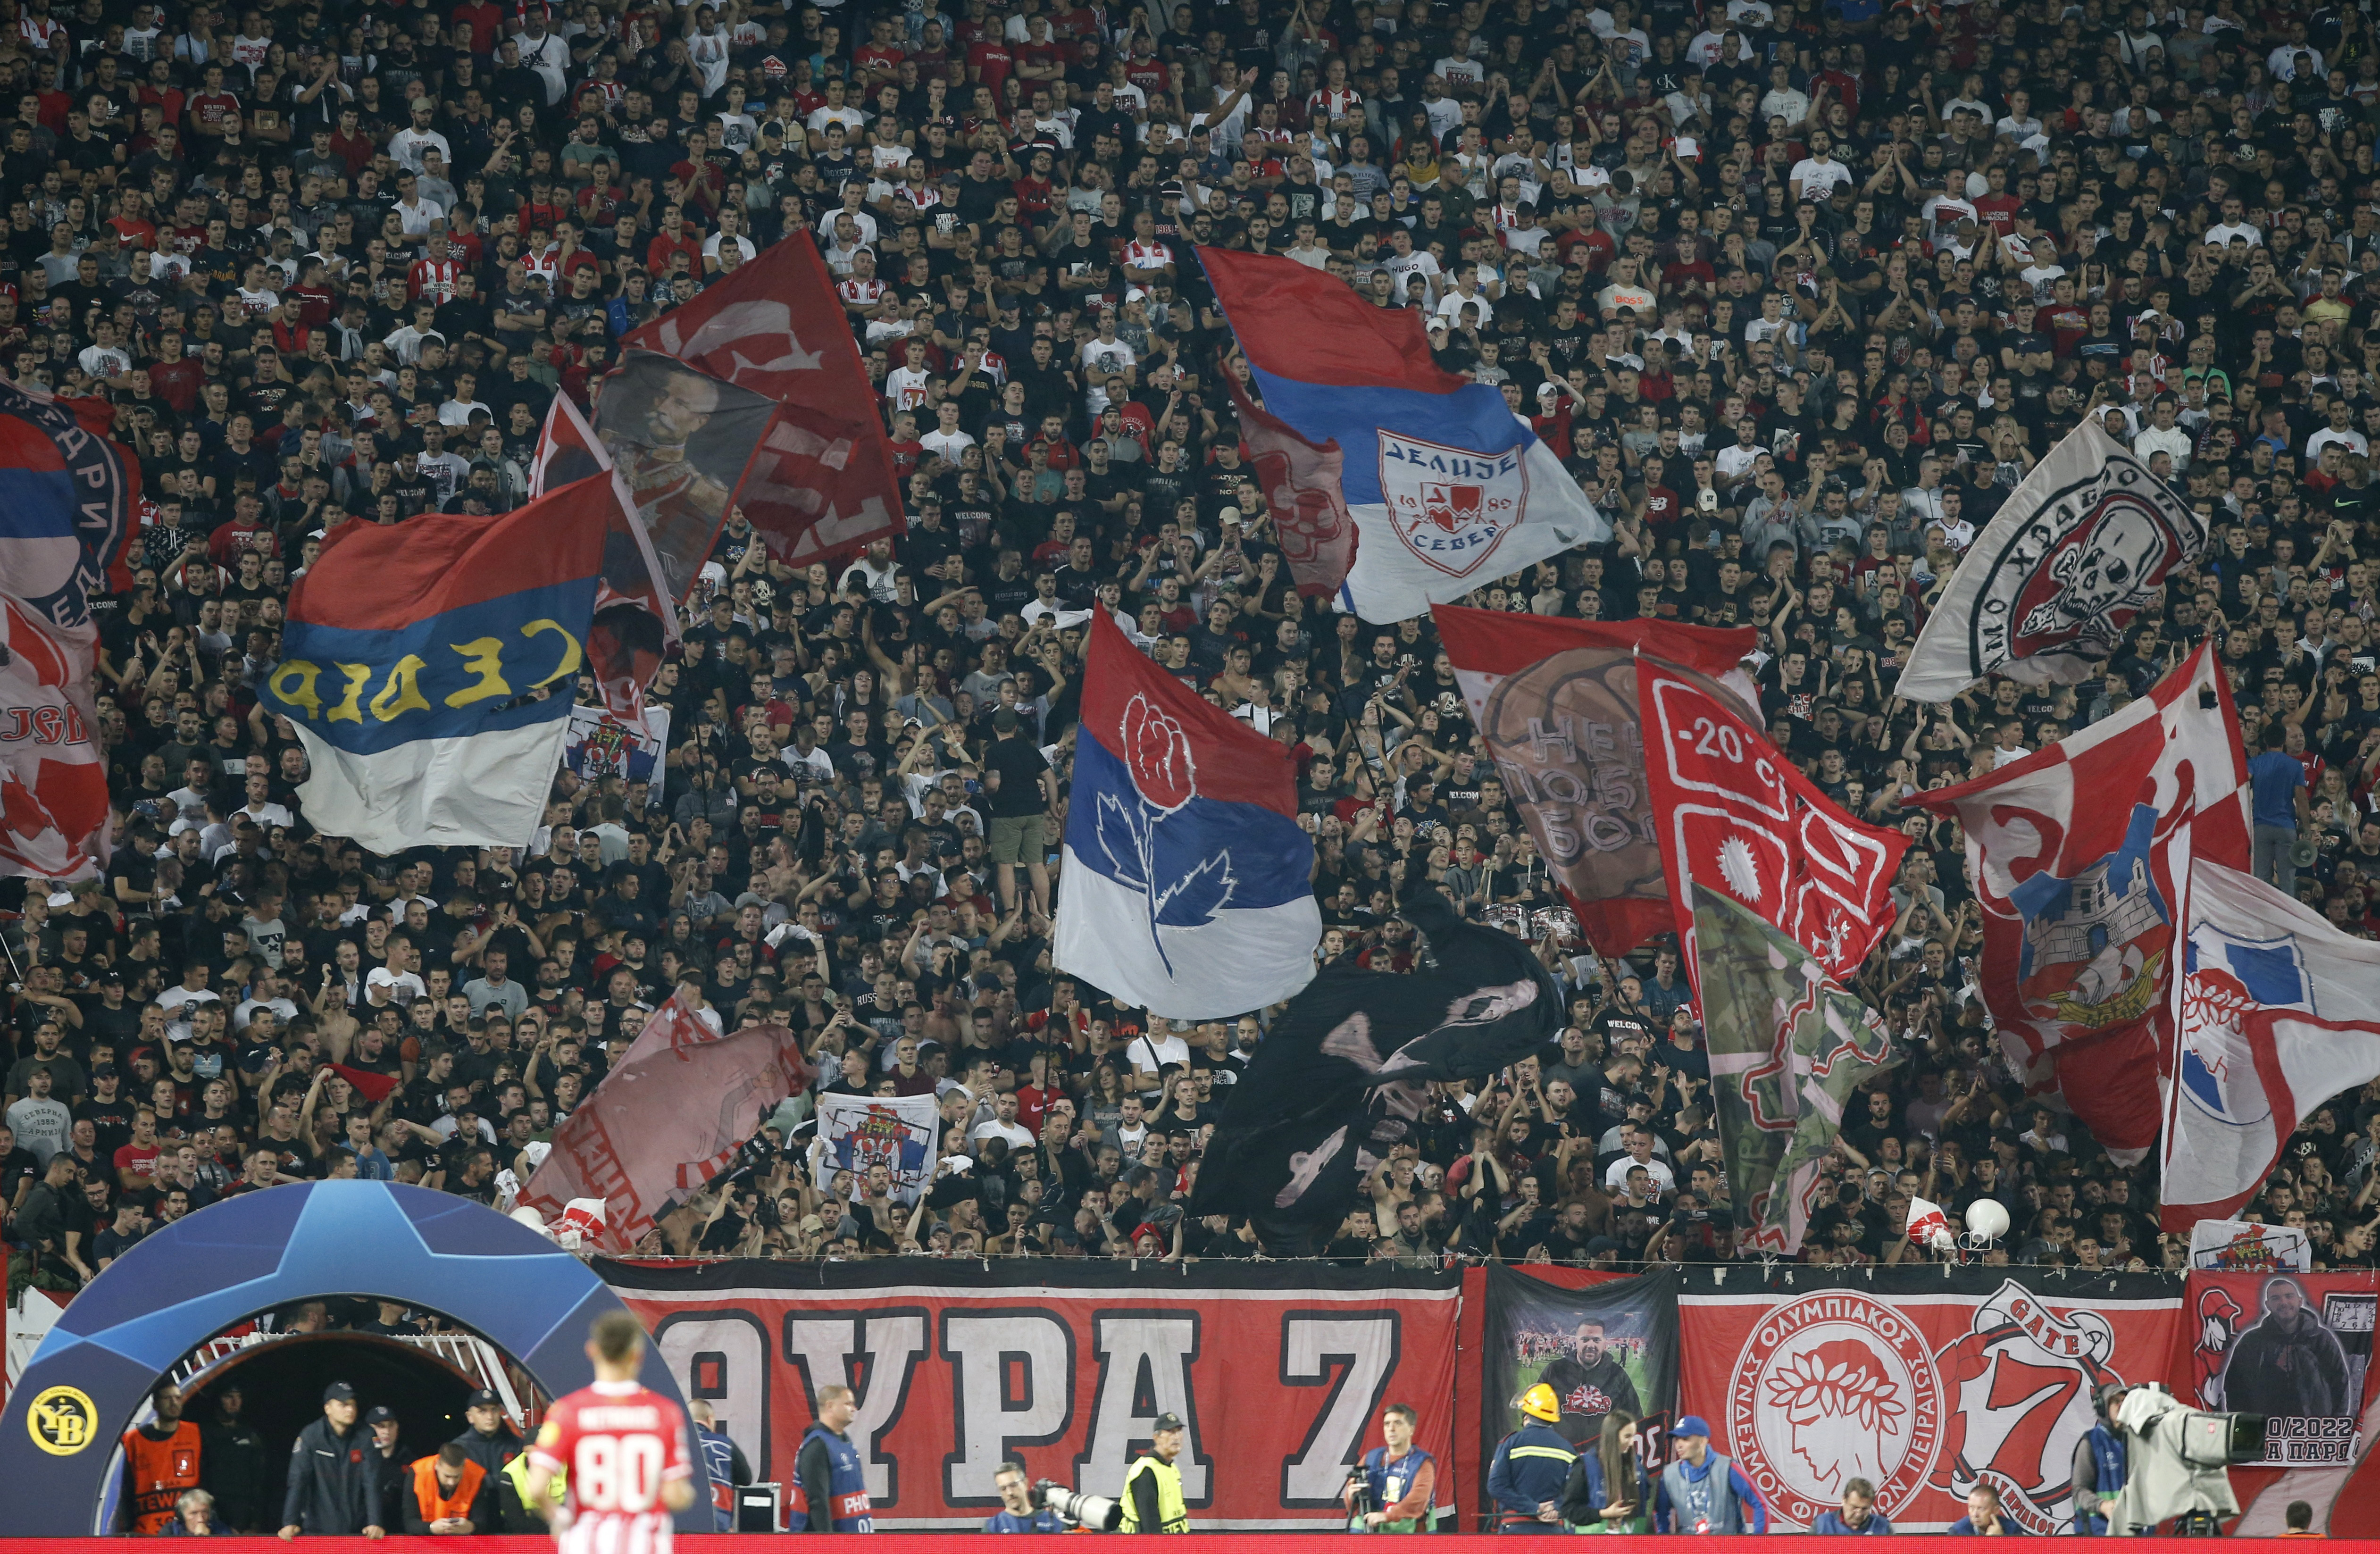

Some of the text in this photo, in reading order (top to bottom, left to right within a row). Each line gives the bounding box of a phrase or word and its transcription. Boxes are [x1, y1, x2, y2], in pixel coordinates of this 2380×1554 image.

[519, 59, 550, 67] addas
[1935, 204, 1969, 213] МАРАКАНА
[1155, 224, 1174, 234] 1989
[386, 251, 412, 259] ELCOME
[1392, 264, 1419, 273] HUGO
[1615, 296, 1644, 304] BOSS
[954, 511, 991, 520] WELCOME
[1413, 526, 1498, 551] СЕВЕР
[88, 601, 117, 610] ELCOME
[1881, 657, 1896, 668] 198
[857, 992, 877, 1006] RUSS
[24, 1108, 63, 1120] СЕВЕРНА
[1760, 1298, 1912, 1350] ΟΛΥΜΠΙΑΚΟΣ
[2010, 1298, 2080, 1355] GATE
[1280, 1309, 1401, 1509] 7
[34, 1404, 87, 1446] YB
[1986, 1349, 2083, 1491] 7
[1735, 1351, 1788, 1505] ΣΥΝΔΕΣΜΟΣ
[1904, 1351, 1936, 1473] ΠΕΙΡΑΙΩΣ
[2267, 1416, 2354, 1439] 0/2022
[574, 1433, 666, 1513] 80
[1980, 1472, 2056, 1536] OLYMPIAKOS
